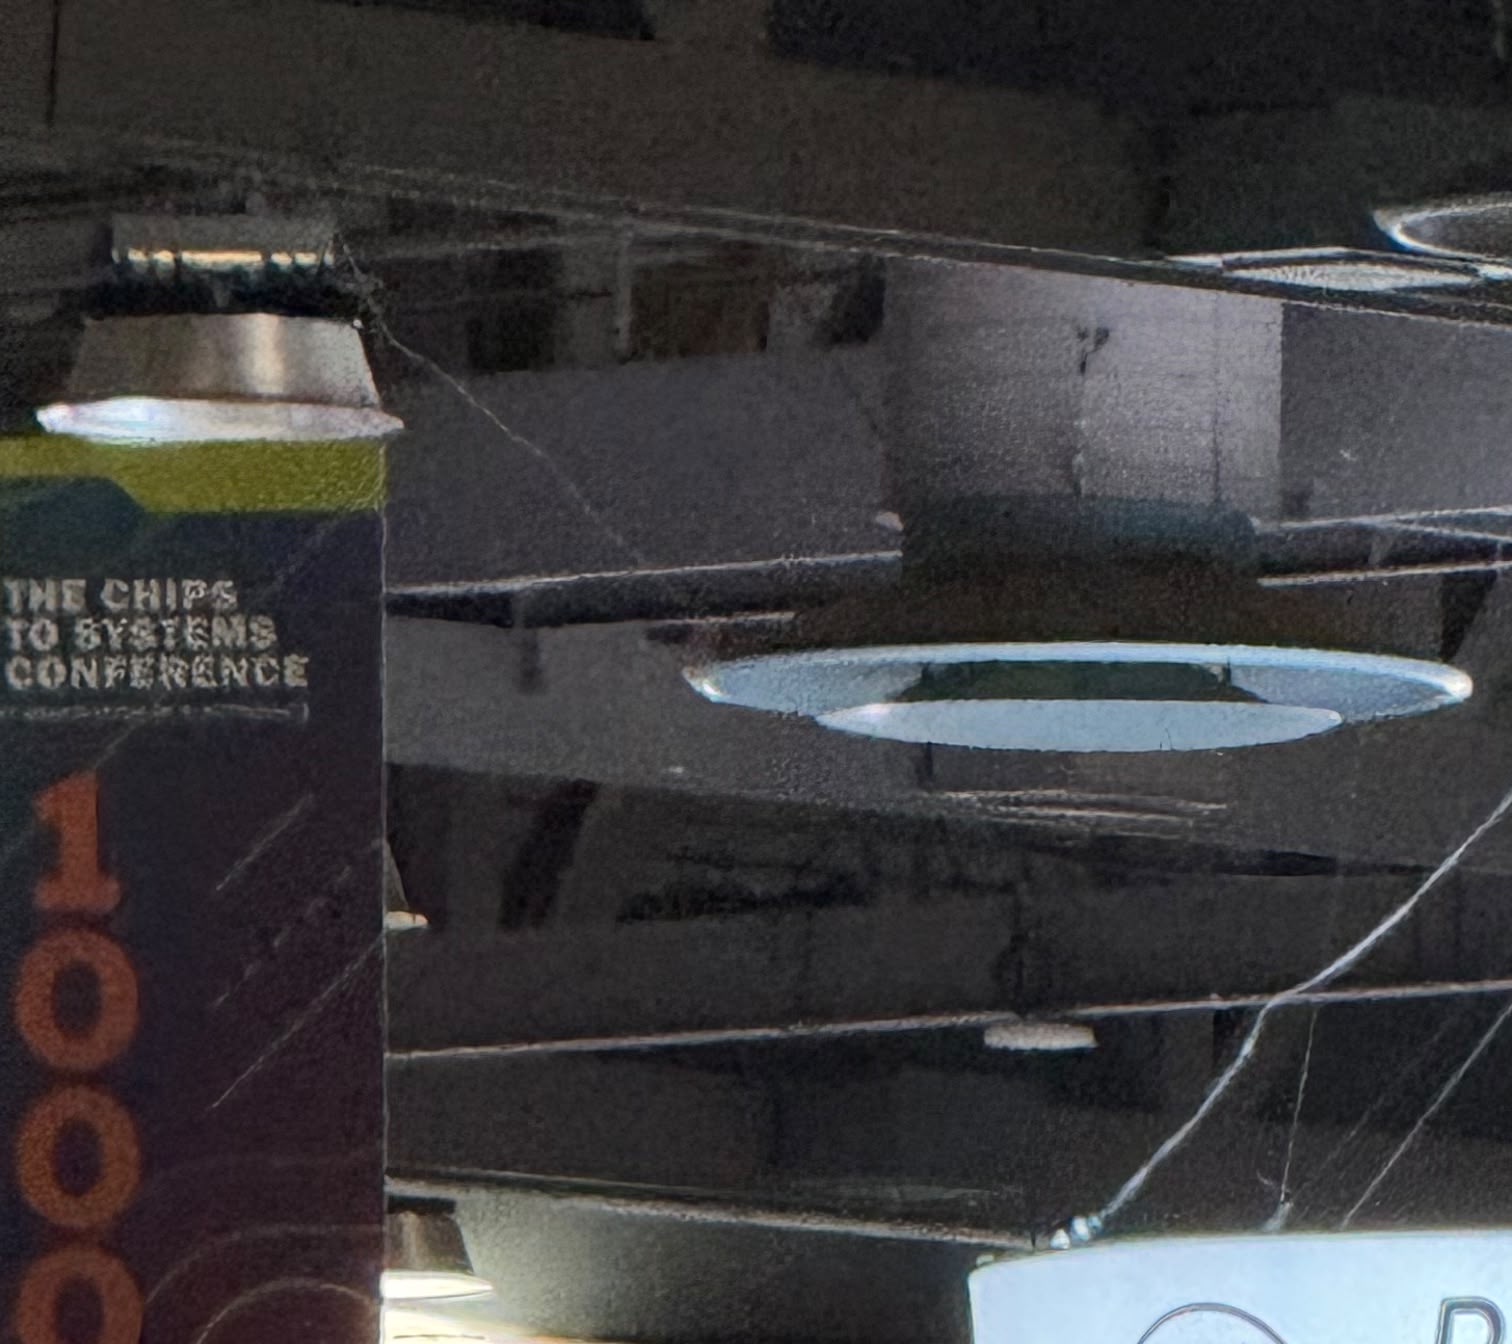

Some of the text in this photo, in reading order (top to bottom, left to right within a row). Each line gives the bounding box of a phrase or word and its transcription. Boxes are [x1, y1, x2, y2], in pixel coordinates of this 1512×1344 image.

[4, 577, 238, 613] THE CHIPS
[5, 614, 278, 651] TO SYSTEMS
[5, 653, 309, 691] CONFERENCE
